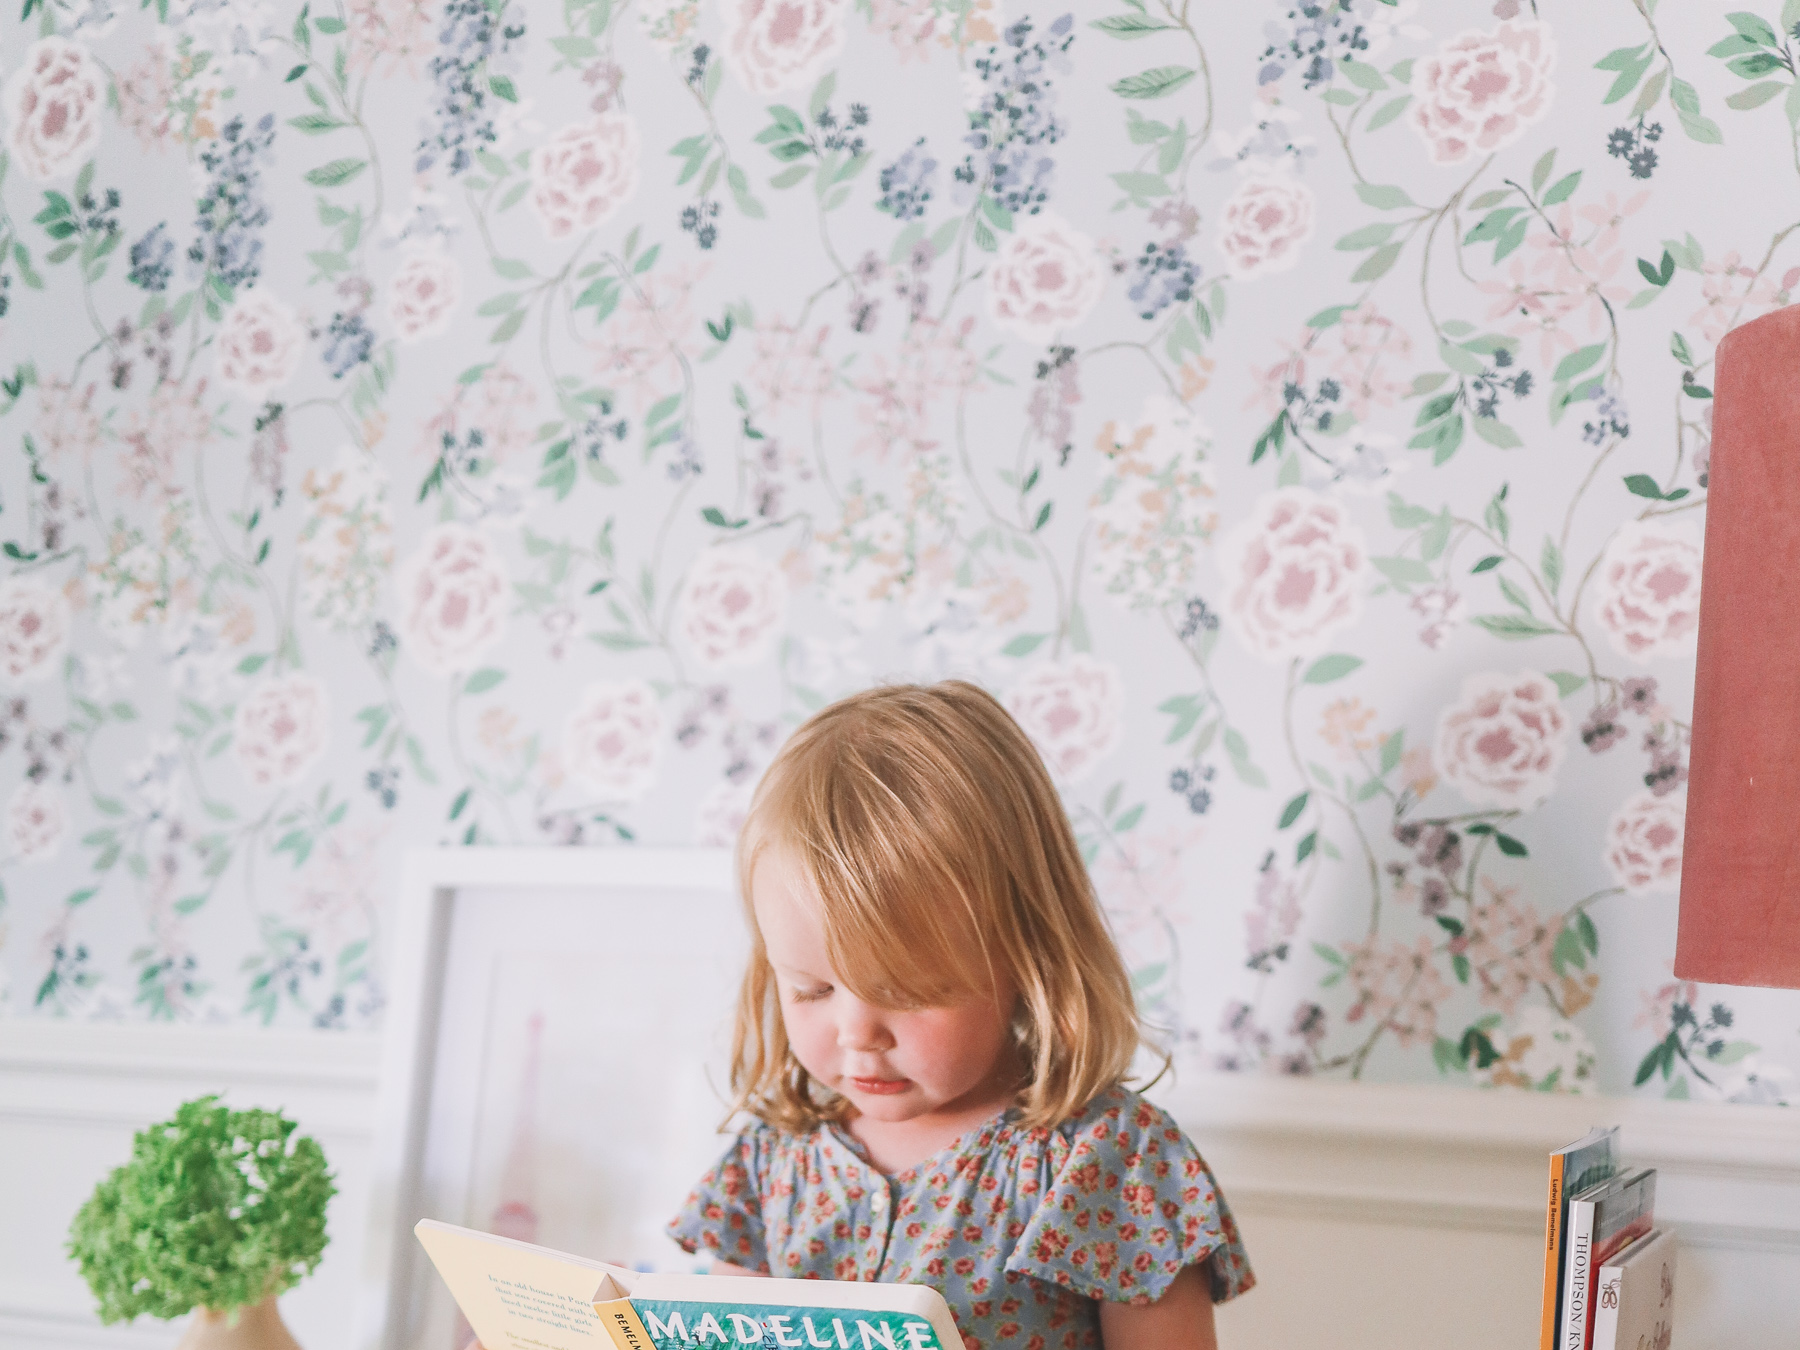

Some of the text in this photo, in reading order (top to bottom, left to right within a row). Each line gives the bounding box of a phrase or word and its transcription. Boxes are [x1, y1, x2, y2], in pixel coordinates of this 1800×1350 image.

[1548, 1178, 1559, 1251] Ludwig Bemelmans
[568, 1295, 591, 1307] Paris
